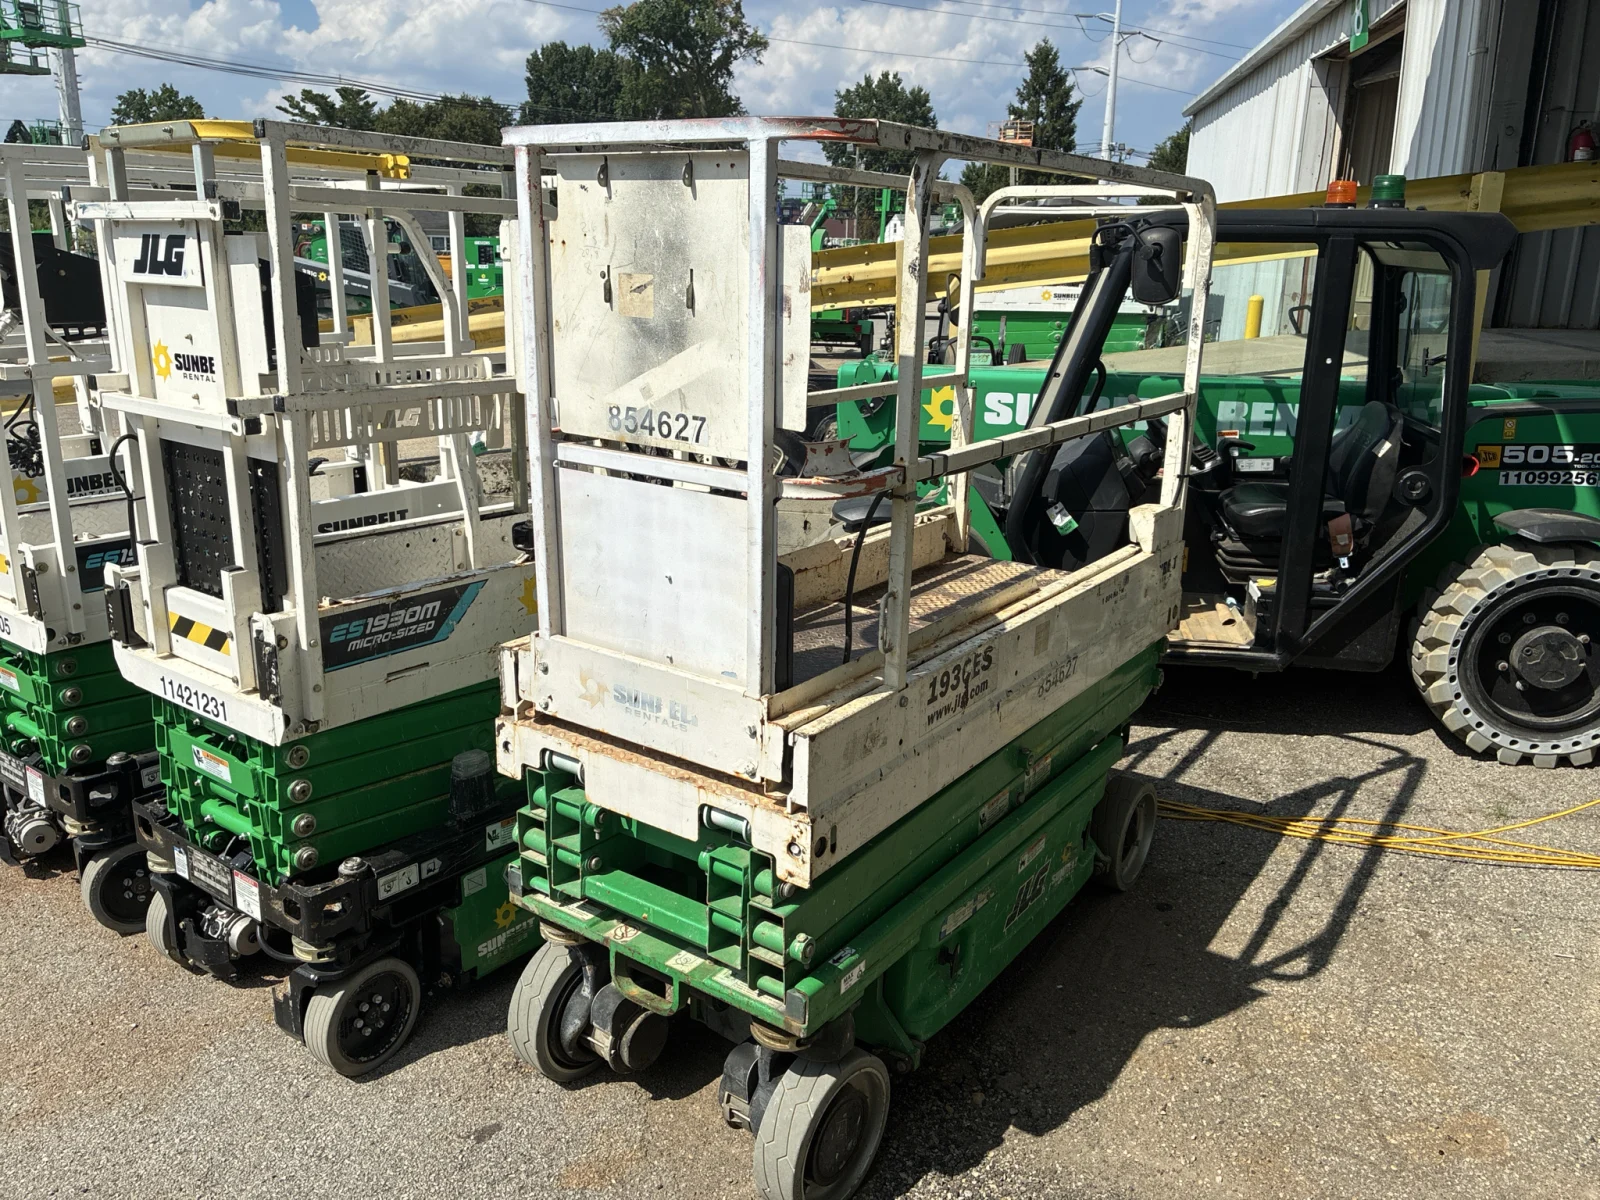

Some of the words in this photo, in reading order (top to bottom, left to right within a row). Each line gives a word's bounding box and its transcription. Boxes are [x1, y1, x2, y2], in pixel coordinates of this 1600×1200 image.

[133, 233, 187, 277] JLG
[173, 353, 216, 375] SUNBE
[183, 372, 216, 383] RENTAL
[608, 405, 707, 444] 854627
[1481, 450, 1499, 462] JCB
[1501, 471, 1597, 485] 11099256
[329, 600, 442, 643] ES1930M
[347, 620, 435, 652] MICRO-SIZED
[160, 675, 228, 722] 11421231
[1002, 857, 1053, 933] JLG
